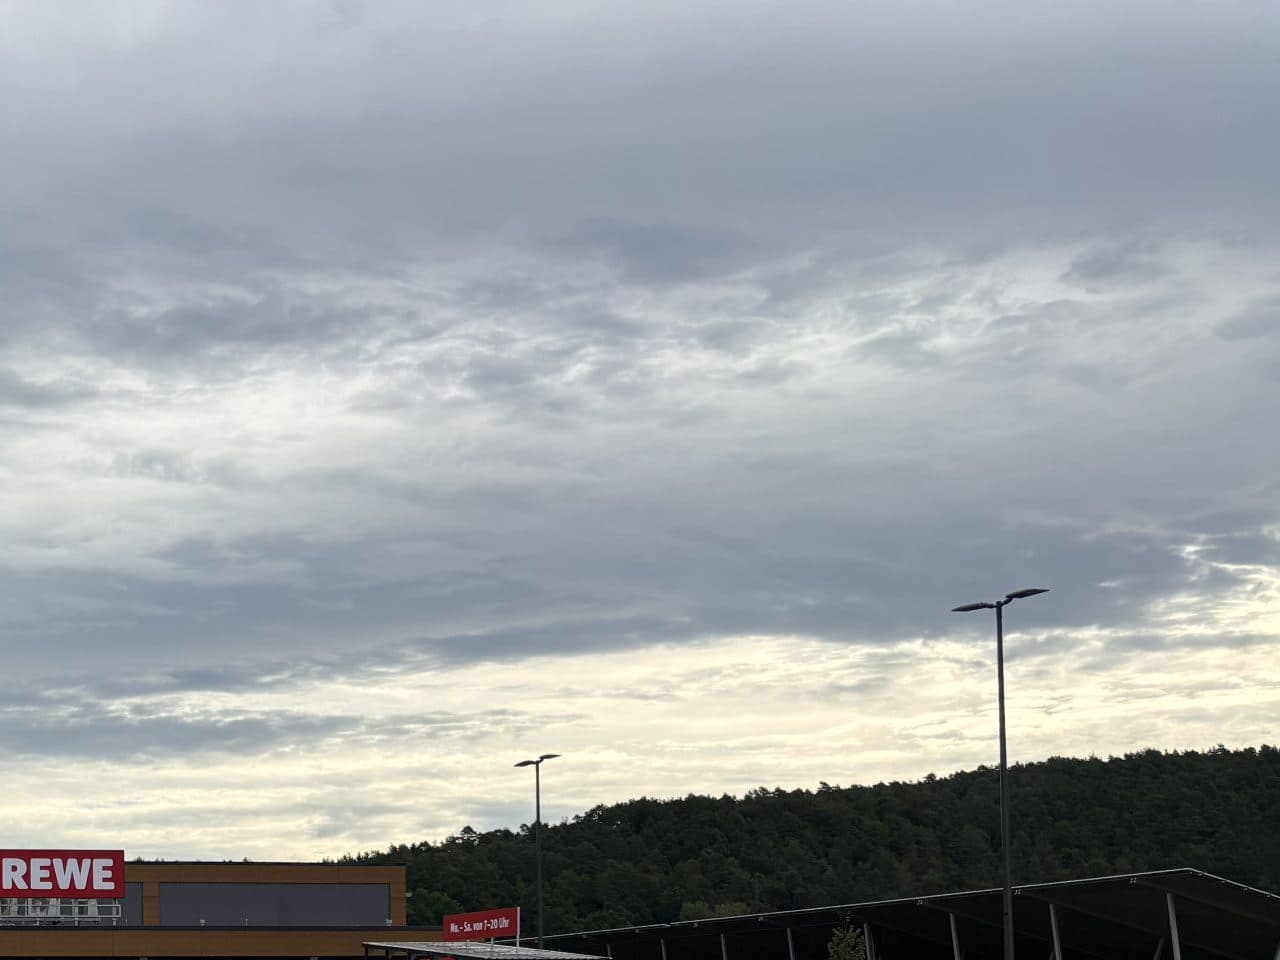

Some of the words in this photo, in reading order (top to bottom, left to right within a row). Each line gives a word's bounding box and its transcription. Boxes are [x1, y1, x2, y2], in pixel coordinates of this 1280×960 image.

[1, 857, 115, 890] REWE
[472, 922, 483, 931] von
[498, 917, 510, 928] Uhr
